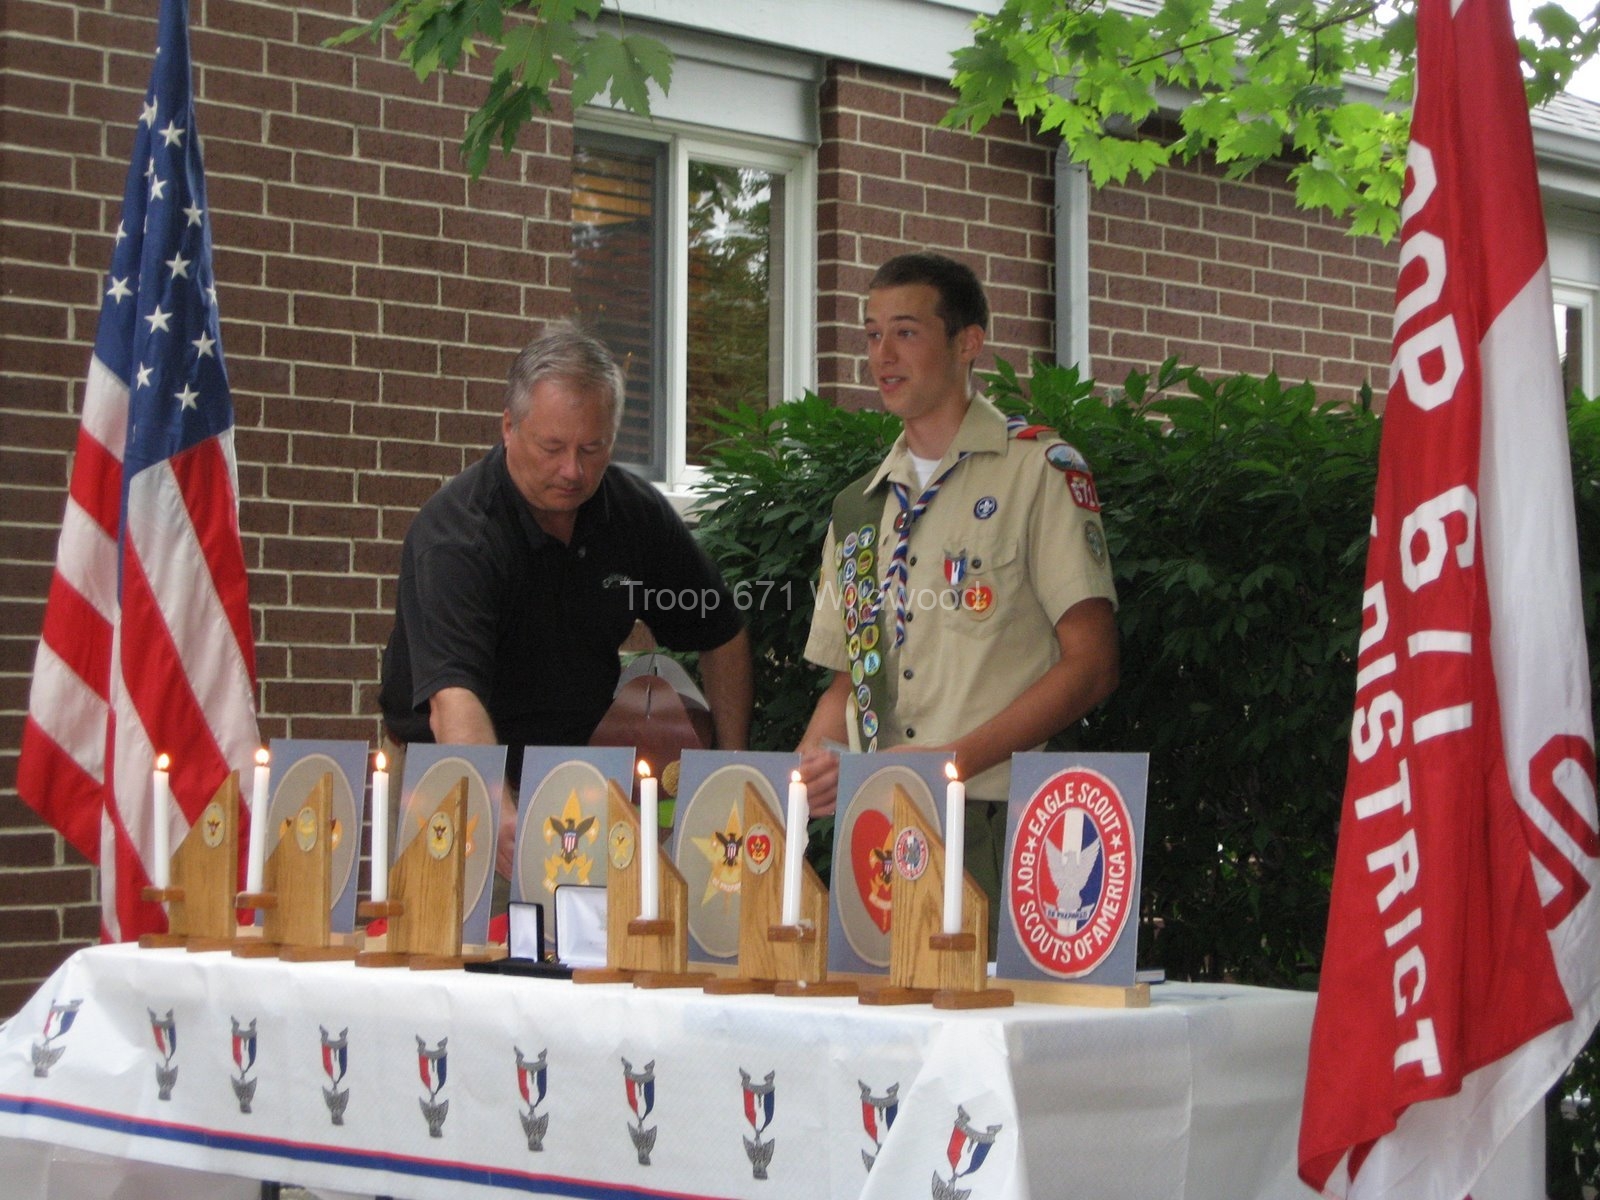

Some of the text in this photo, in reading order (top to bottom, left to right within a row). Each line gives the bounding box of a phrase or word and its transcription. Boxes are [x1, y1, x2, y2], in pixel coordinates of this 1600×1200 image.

[1400, 484, 1477, 745] 611
[1028, 782, 1121, 837] EAGLE SCOUT
[1350, 581, 1442, 1077] DISTRICT
[1017, 851, 1126, 964] BOY SCOUTS OF AMERICA
